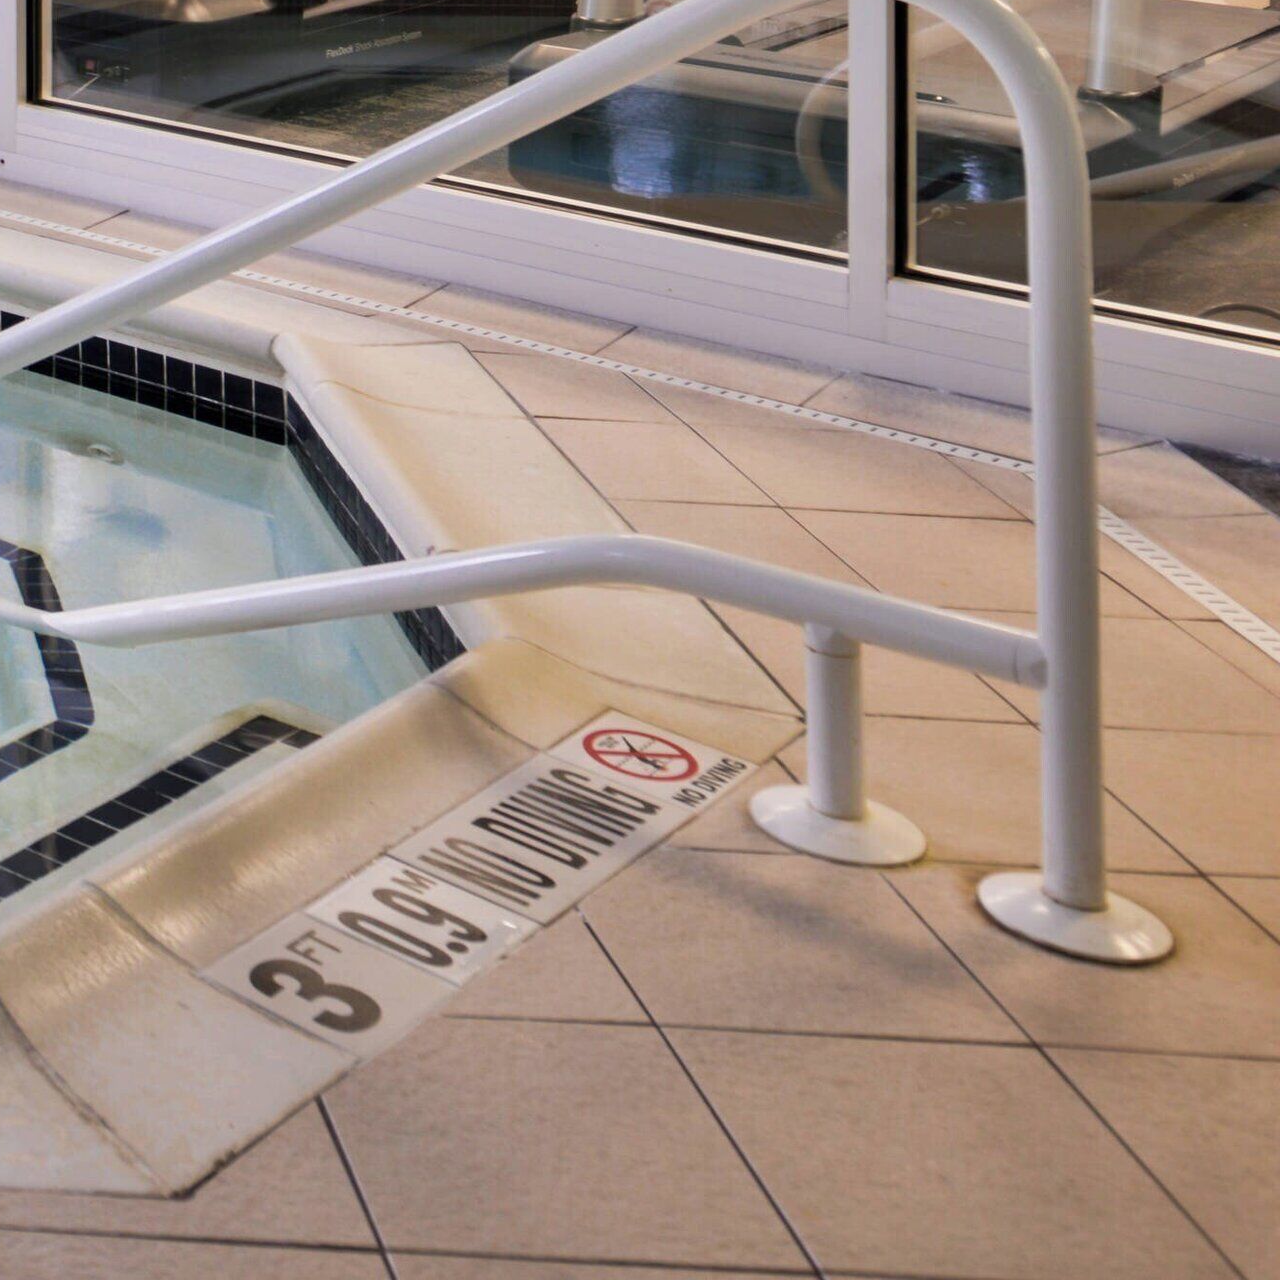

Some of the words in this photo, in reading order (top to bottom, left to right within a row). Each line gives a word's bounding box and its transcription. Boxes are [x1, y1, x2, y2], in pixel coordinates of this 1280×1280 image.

[672, 787, 707, 808] NO
[691, 757, 748, 794] DIVING
[470, 768, 661, 871] DIVING
[417, 837, 557, 908] NO
[285, 930, 343, 967] FT
[249, 958, 382, 1033] 3
